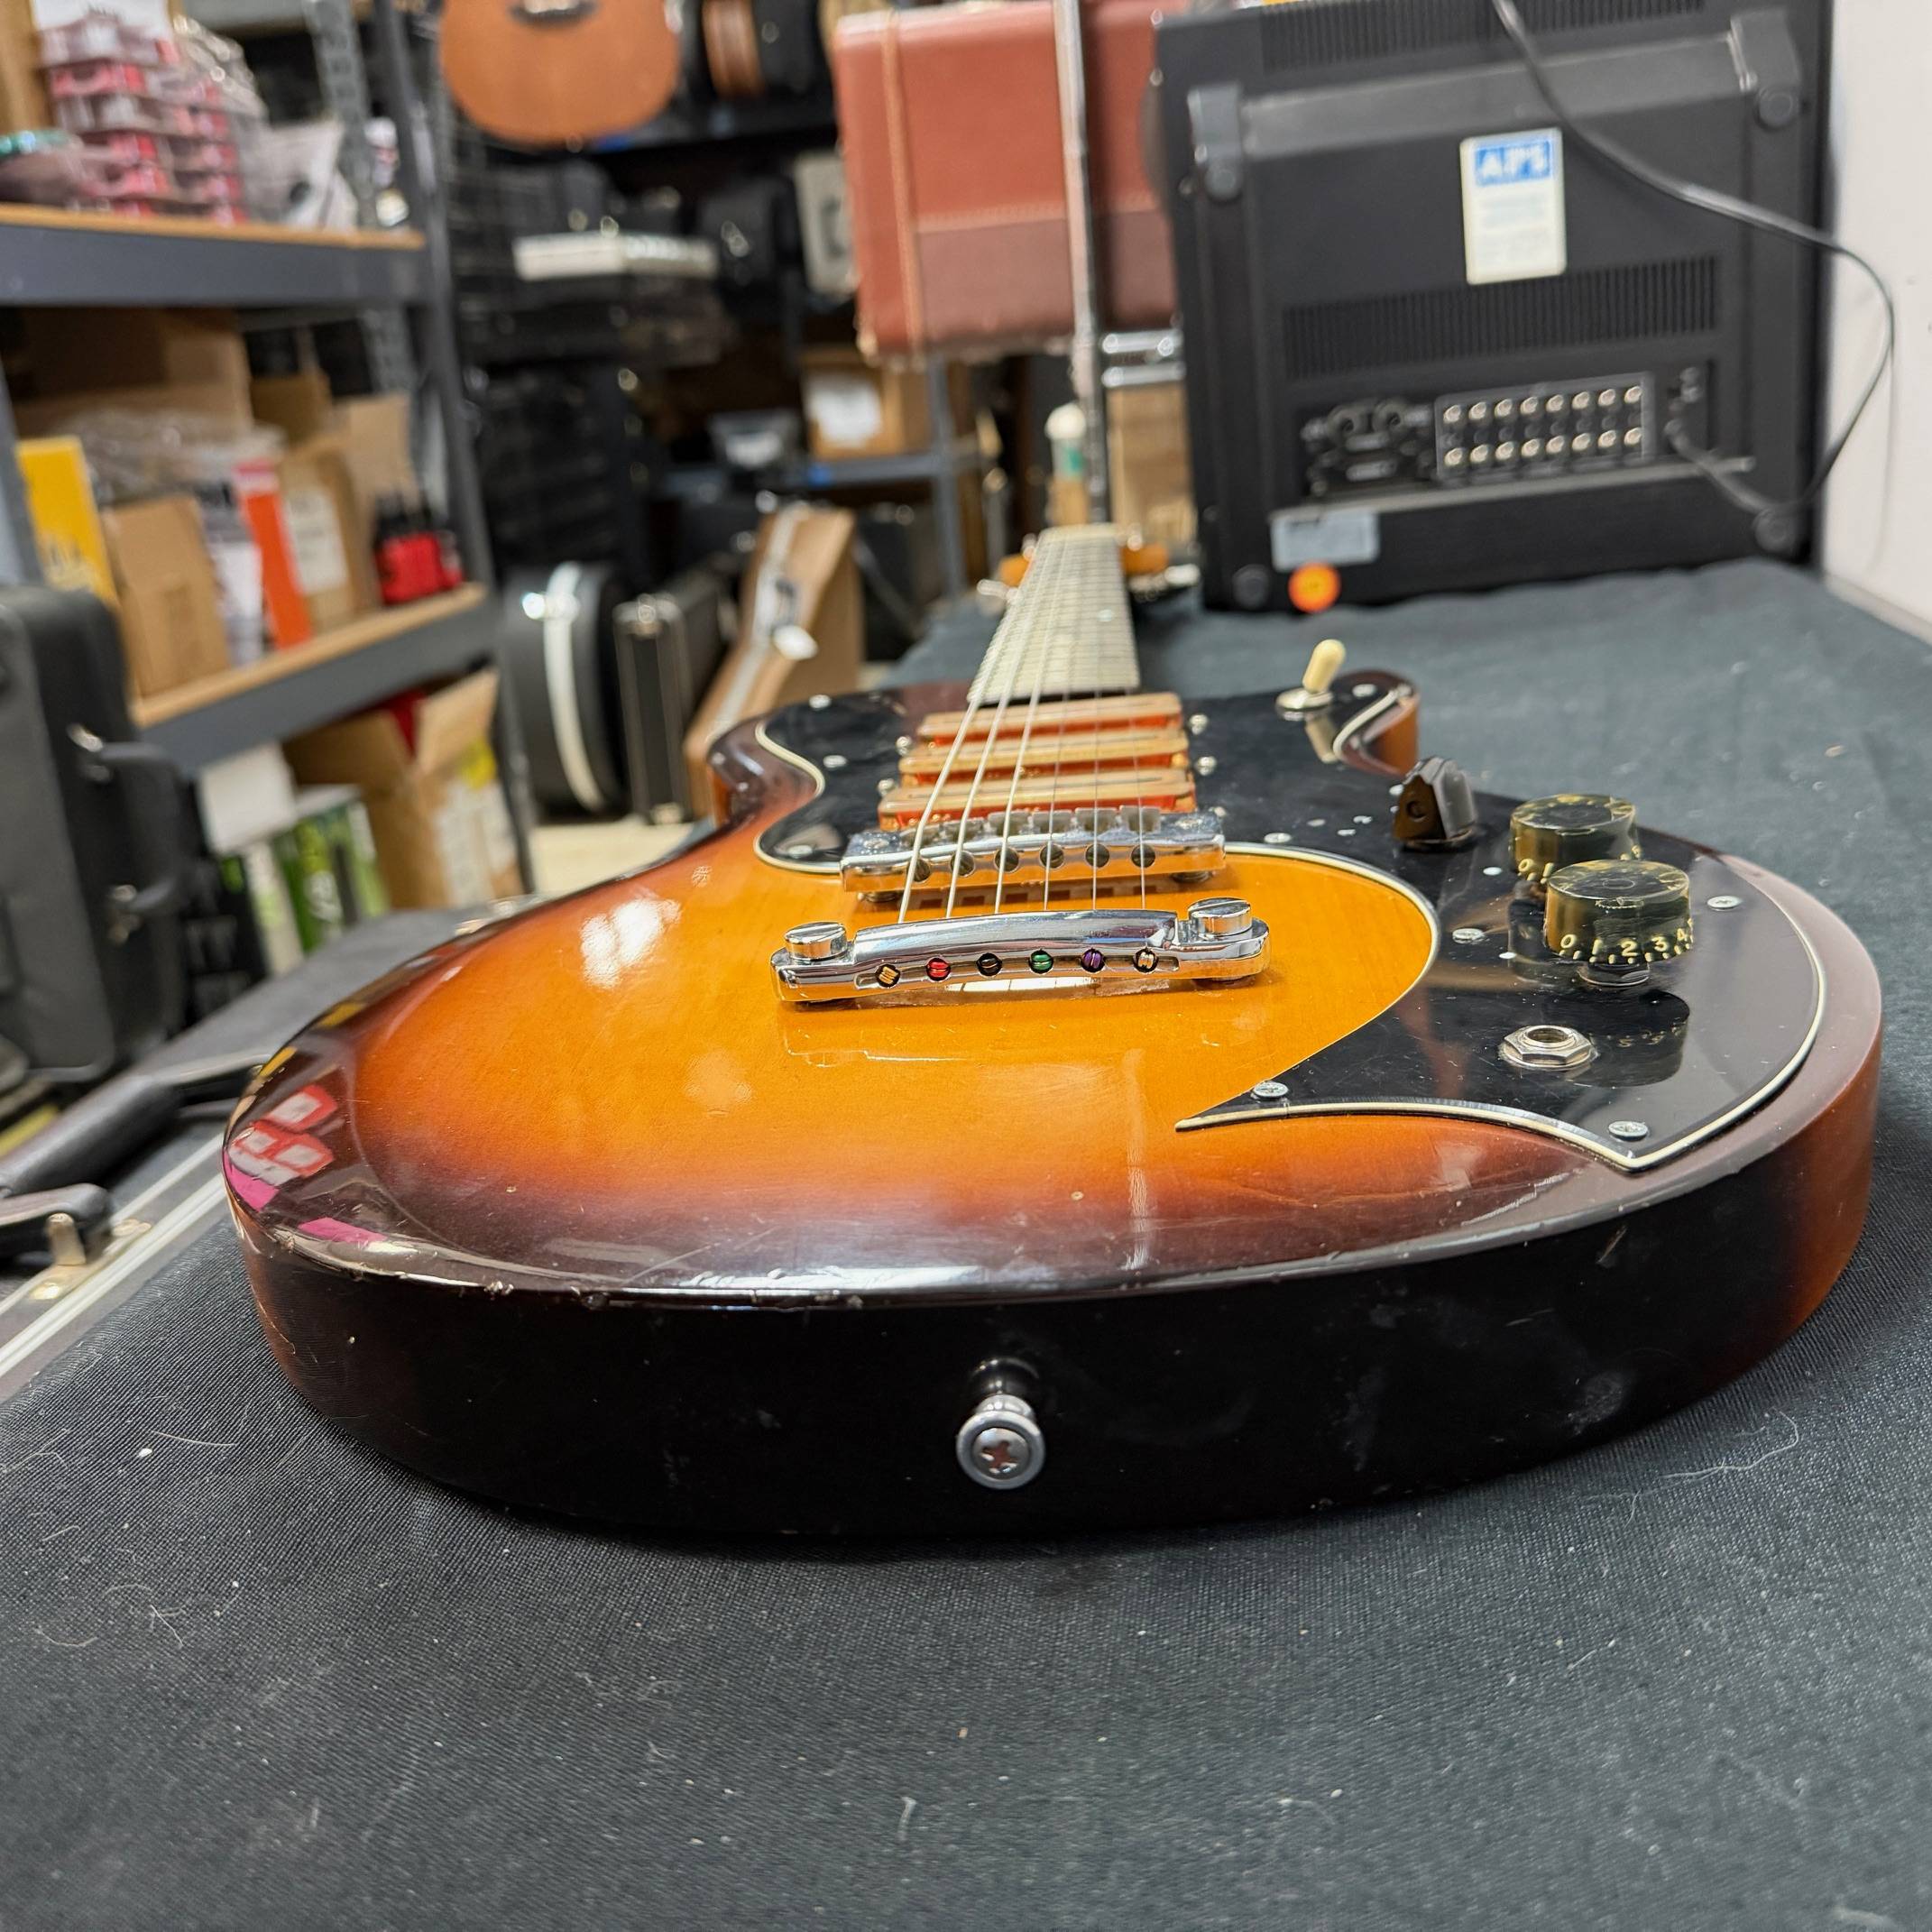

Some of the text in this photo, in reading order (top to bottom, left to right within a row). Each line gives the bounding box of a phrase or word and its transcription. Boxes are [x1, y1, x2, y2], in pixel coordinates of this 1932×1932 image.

[1560, 934, 1577, 949] 0
[1592, 938, 1603, 955] 1
[1621, 939, 1638, 956] 2
[1651, 935, 1669, 952] 3
[1677, 927, 1688, 942] 4
